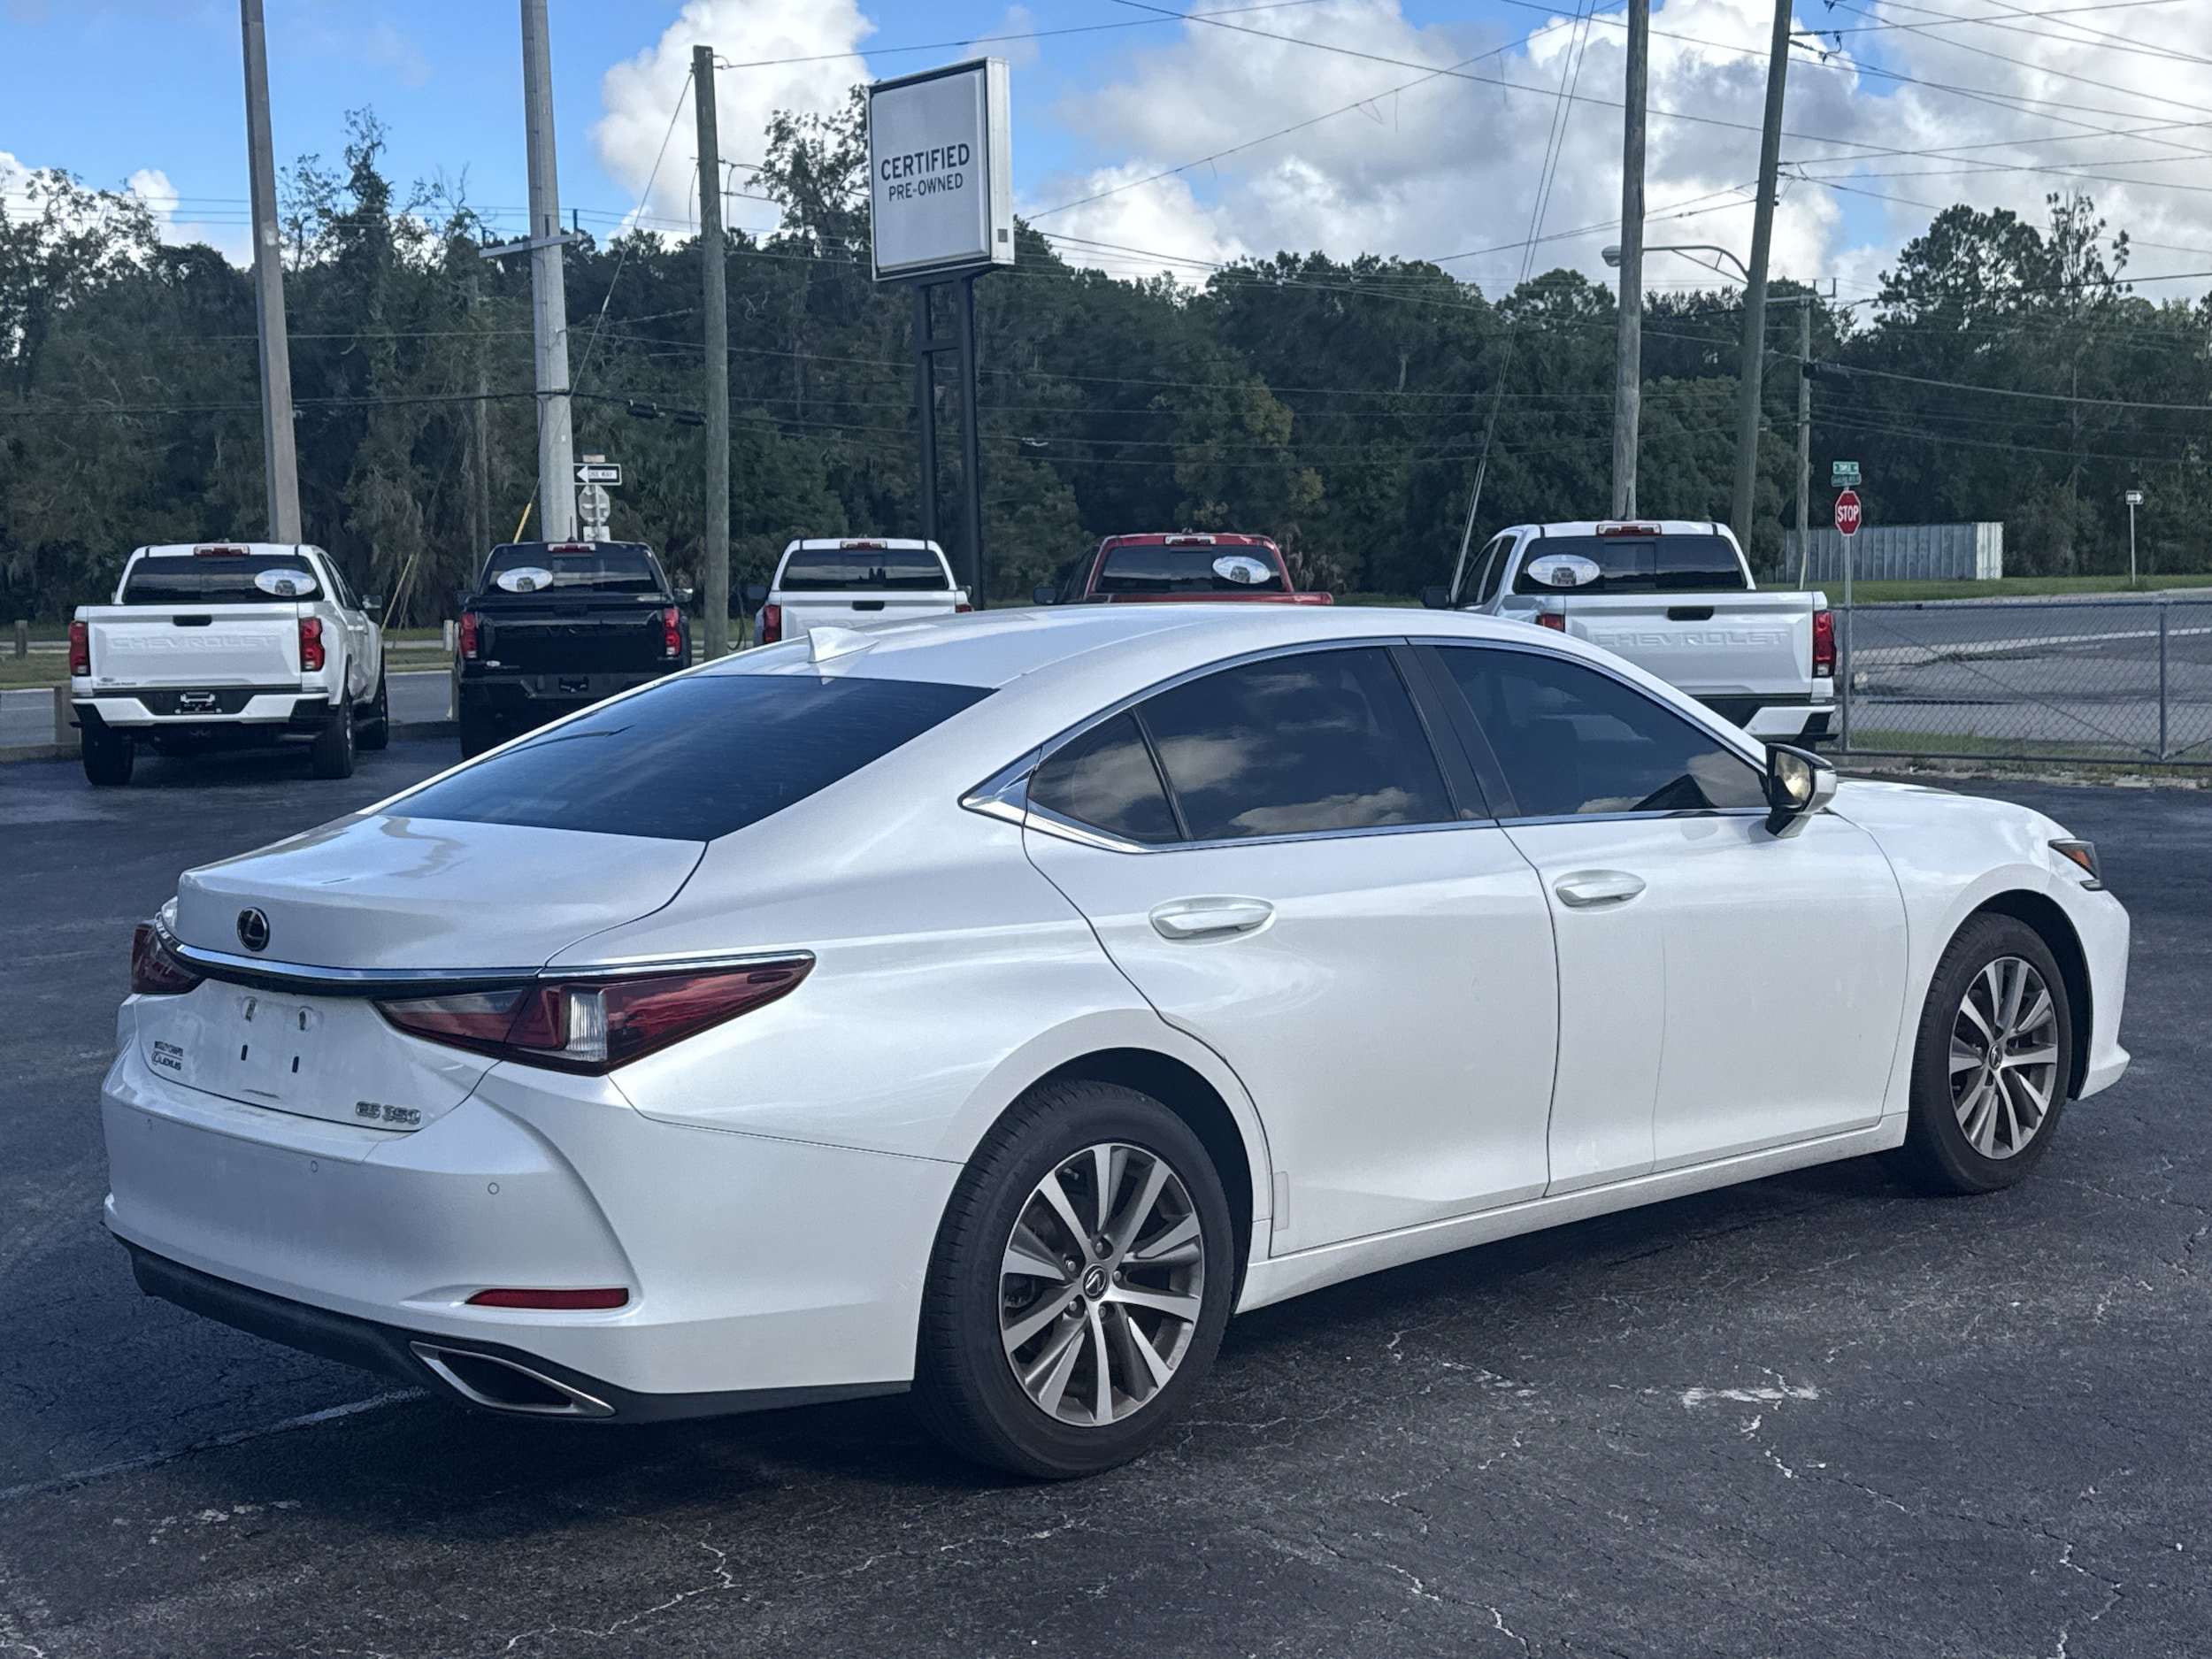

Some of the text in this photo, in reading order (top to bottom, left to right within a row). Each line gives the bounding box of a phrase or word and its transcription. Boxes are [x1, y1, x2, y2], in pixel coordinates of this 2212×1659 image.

[880, 143, 970, 180] CERTIFIED
[888, 173, 964, 202] PRE-OWNED
[1837, 504, 1859, 522] STOP
[111, 634, 280, 649] CHEVROLET
[1593, 631, 1788, 647] CHEVROLET
[157, 1055, 181, 1071] LEXUS
[382, 1103, 421, 1125] 350
